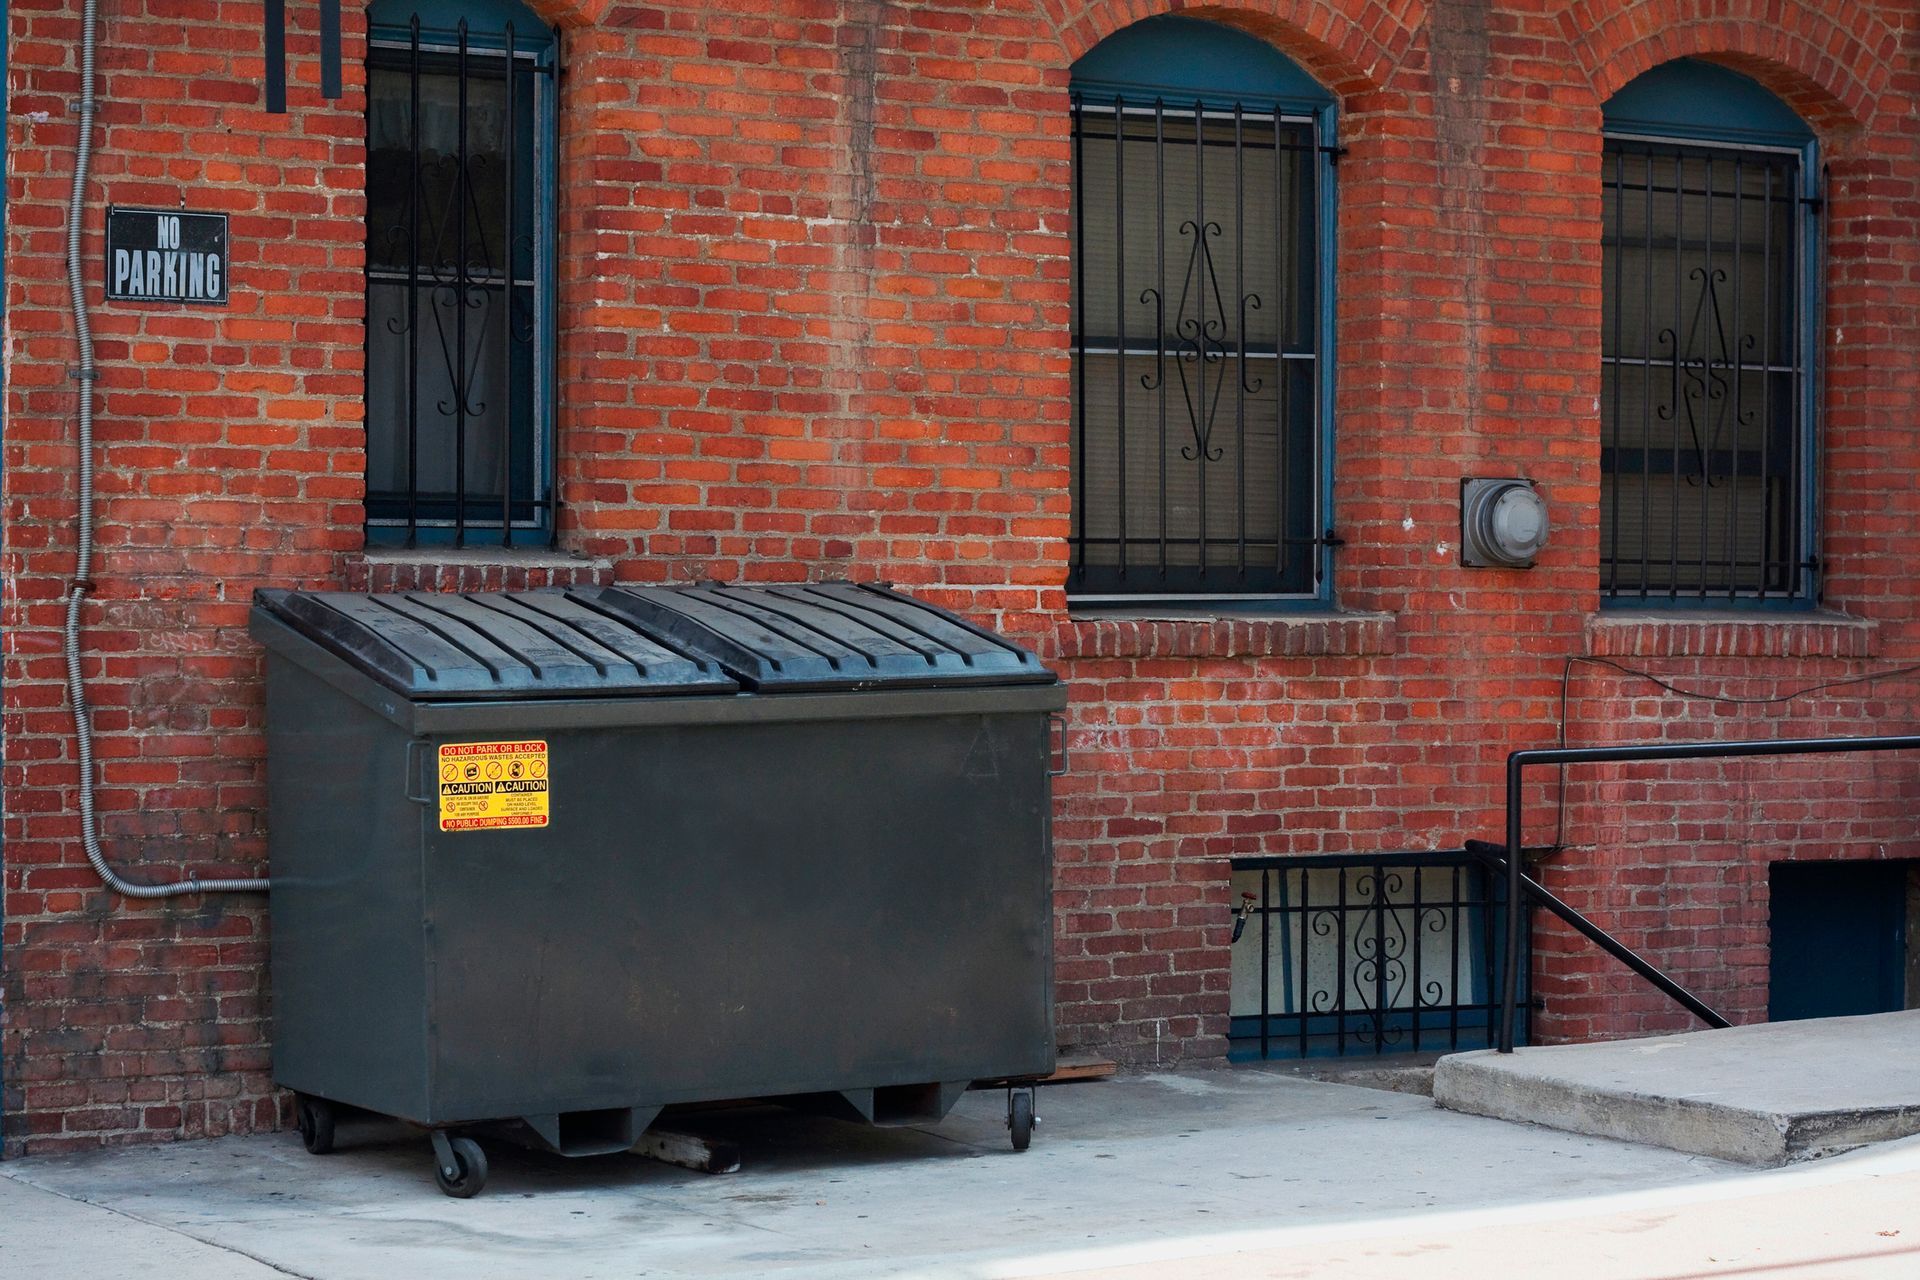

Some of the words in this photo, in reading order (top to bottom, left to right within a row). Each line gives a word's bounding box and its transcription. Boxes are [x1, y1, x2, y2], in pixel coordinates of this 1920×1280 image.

[158, 216, 180, 249] NO
[115, 249, 220, 298] PARKING
[458, 746, 474, 754] NOT
[476, 745, 498, 753] PARK
[500, 744, 512, 752] OR
[514, 744, 542, 752] BLOCK
[451, 783, 492, 794] CAUTION
[506, 780, 545, 791] CAUTION
[446, 820, 455, 828] NO
[457, 819, 478, 827] PUBLIC
[479, 818, 507, 827] DUMPING
[508, 816, 529, 825] $500.00
[530, 816, 543, 824] FINE
